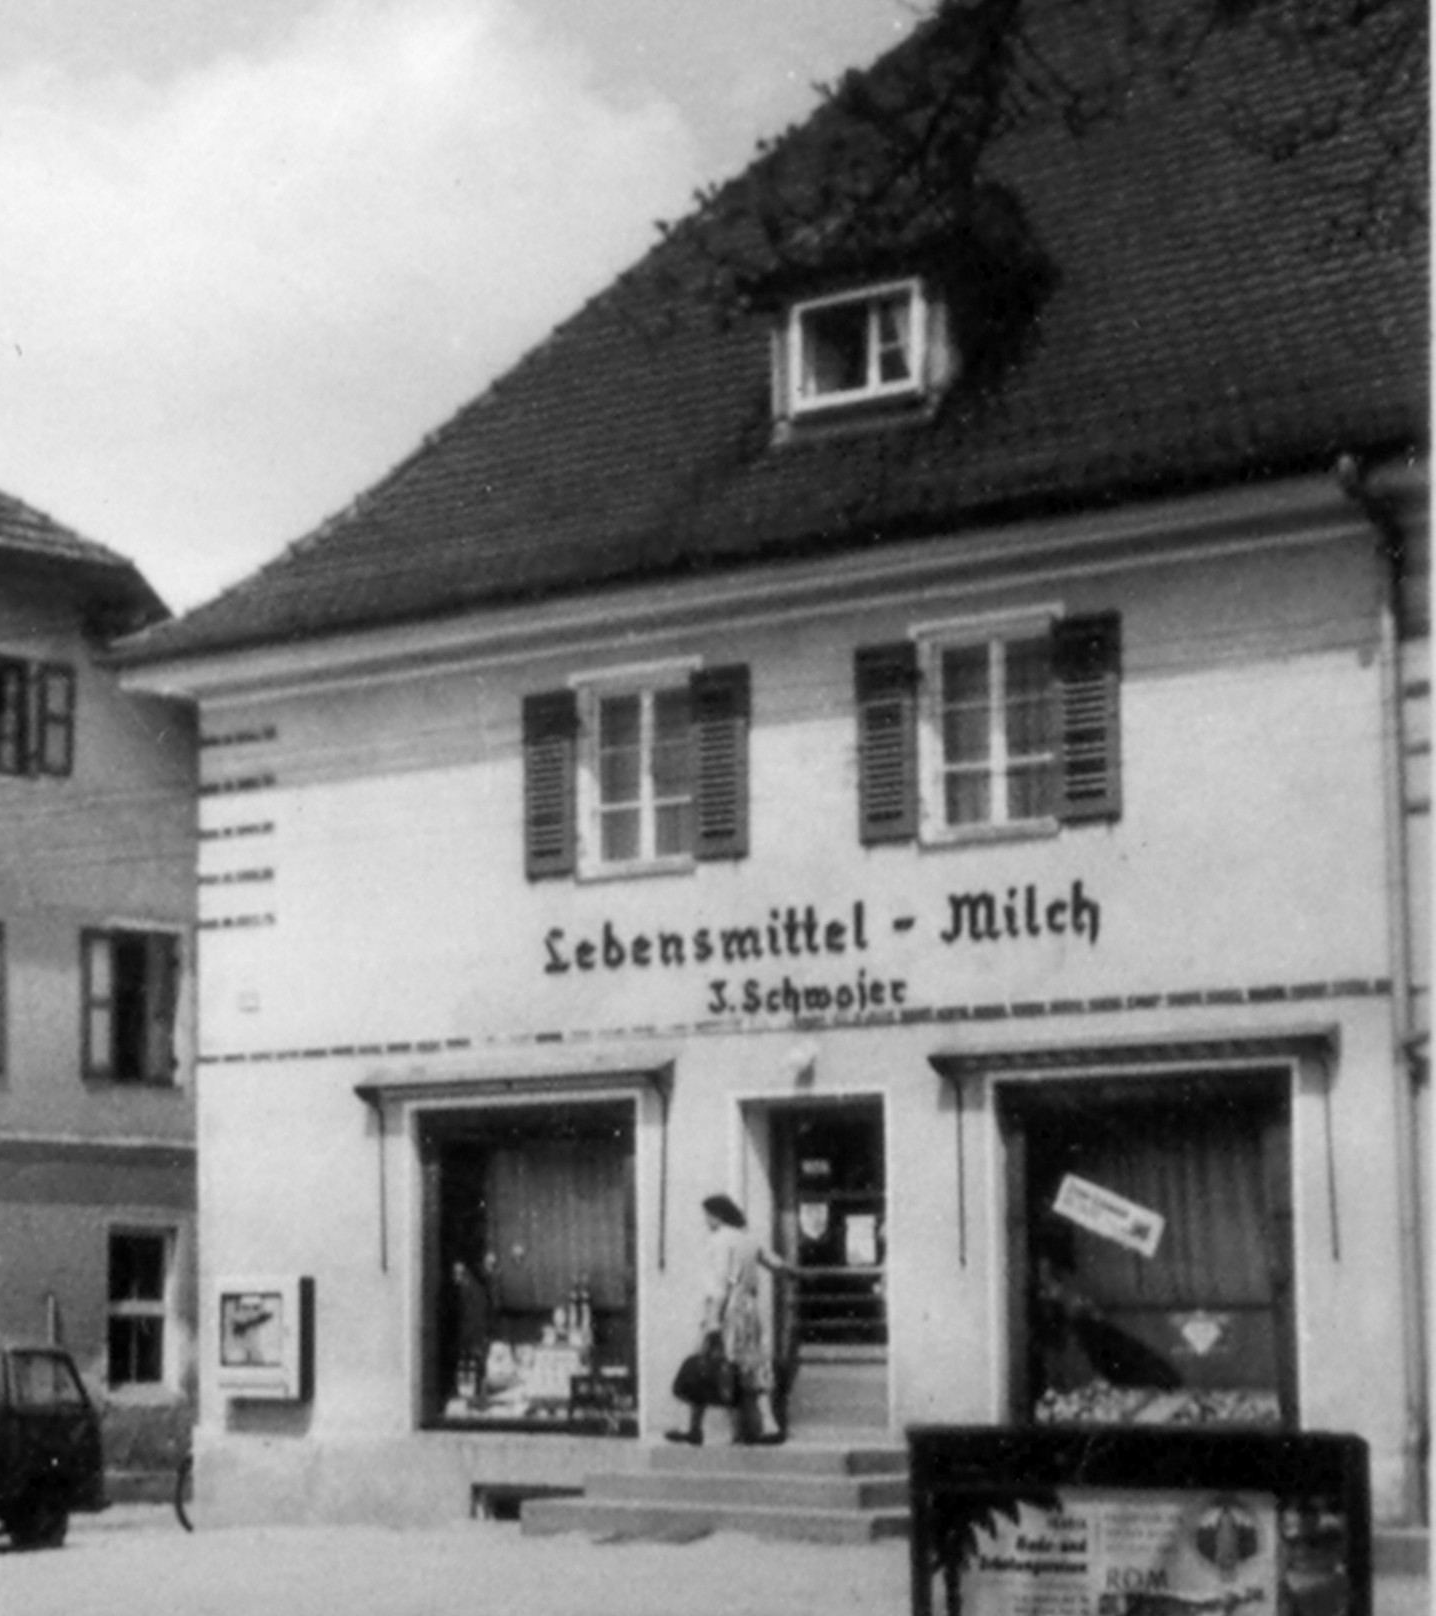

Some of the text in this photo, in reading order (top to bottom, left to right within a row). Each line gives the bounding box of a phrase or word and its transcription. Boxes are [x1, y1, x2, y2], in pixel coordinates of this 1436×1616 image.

[542, 901, 868, 974] Lebensmittel
[940, 880, 1101, 946] Milch
[1105, 1567, 1169, 1590] ROM
